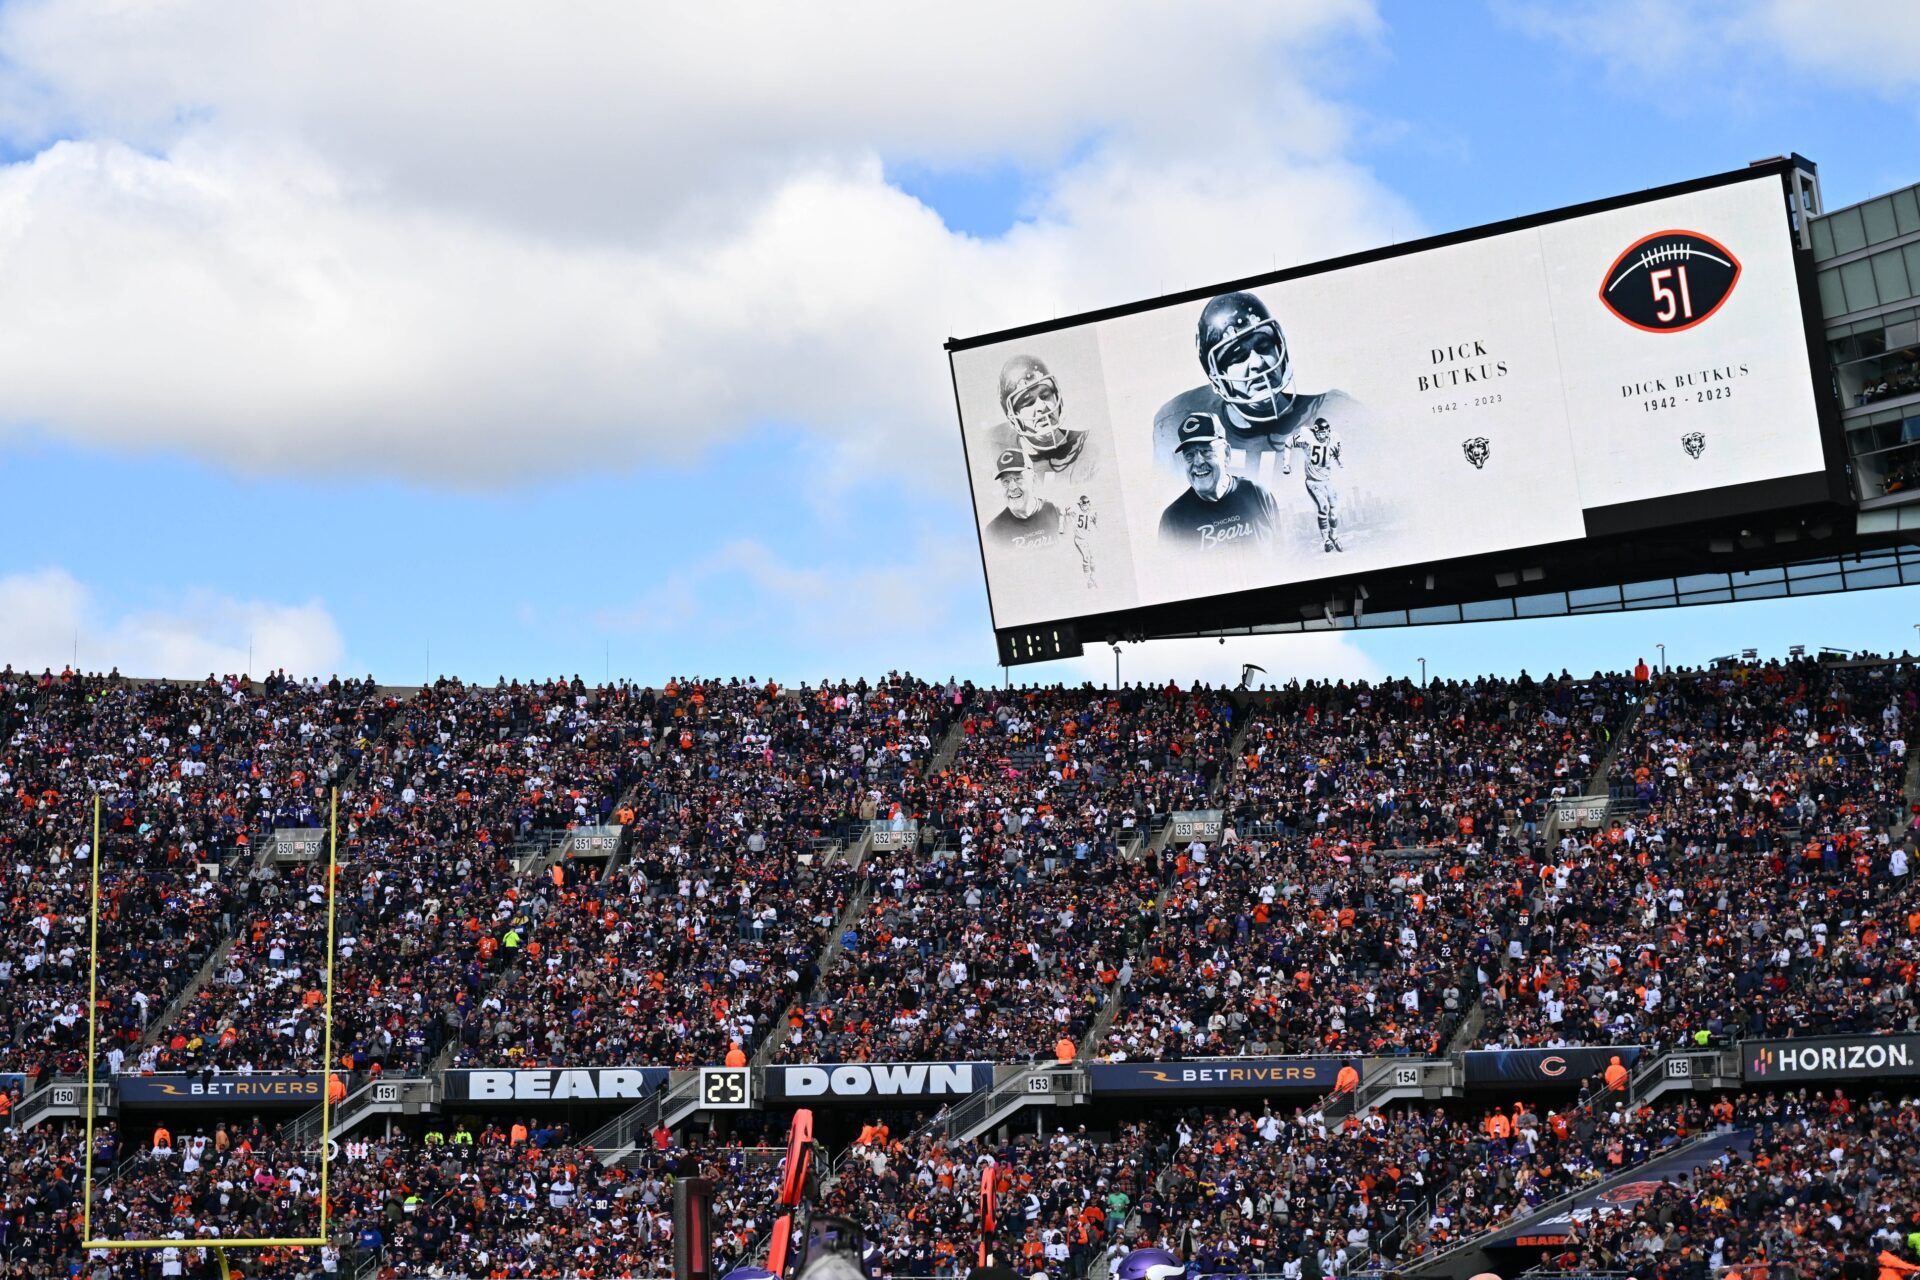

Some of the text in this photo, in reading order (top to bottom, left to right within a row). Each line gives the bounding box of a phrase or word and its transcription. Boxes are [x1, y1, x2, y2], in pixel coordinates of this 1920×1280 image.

[1650, 265, 1693, 323] 51
[1431, 340, 1487, 364] DICK
[1418, 361, 1508, 391] BUTKUS
[1621, 363, 1749, 398] DICK BUTKUS
[1432, 403, 1457, 413] 1942
[1475, 394, 1502, 406] 2023
[1644, 397, 1676, 412] 1942
[1697, 387, 1731, 403] 2023
[1311, 446, 1326, 467] 51
[1078, 515, 1088, 529] 51
[1213, 515, 1241, 527] CHICAGO
[1196, 523, 1253, 550] Bears
[1560, 811, 1575, 821] 354
[1589, 809, 1604, 820] 355
[1177, 823, 1191, 835] 353
[875, 833, 889, 844] 352
[903, 832, 917, 843] 353
[278, 843, 292, 854] 350
[575, 838, 590, 850] 351
[1519, 916, 1528, 926] 99
[1441, 947, 1451, 957] 22
[1626, 996, 1635, 1004] 34
[1778, 1043, 1907, 1072] HORIZON
[1670, 1061, 1688, 1074] 155
[785, 1065, 972, 1096] DOWN
[1183, 1067, 1316, 1082] BETRIVERS
[1397, 1070, 1417, 1083] 154
[191, 1082, 318, 1095] BETRIVERS
[469, 1070, 643, 1100] BEAR
[707, 1074, 743, 1102] 25
[1028, 1077, 1048, 1090] 153
[55, 1090, 73, 1102] 150
[379, 1087, 396, 1099] 151
[1557, 1120, 1567, 1128] 34
[281, 1200, 290, 1209] 51
[1296, 1197, 1306, 1208] 22
[394, 1237, 404, 1246] 52
[1240, 1235, 1250, 1246] 34
